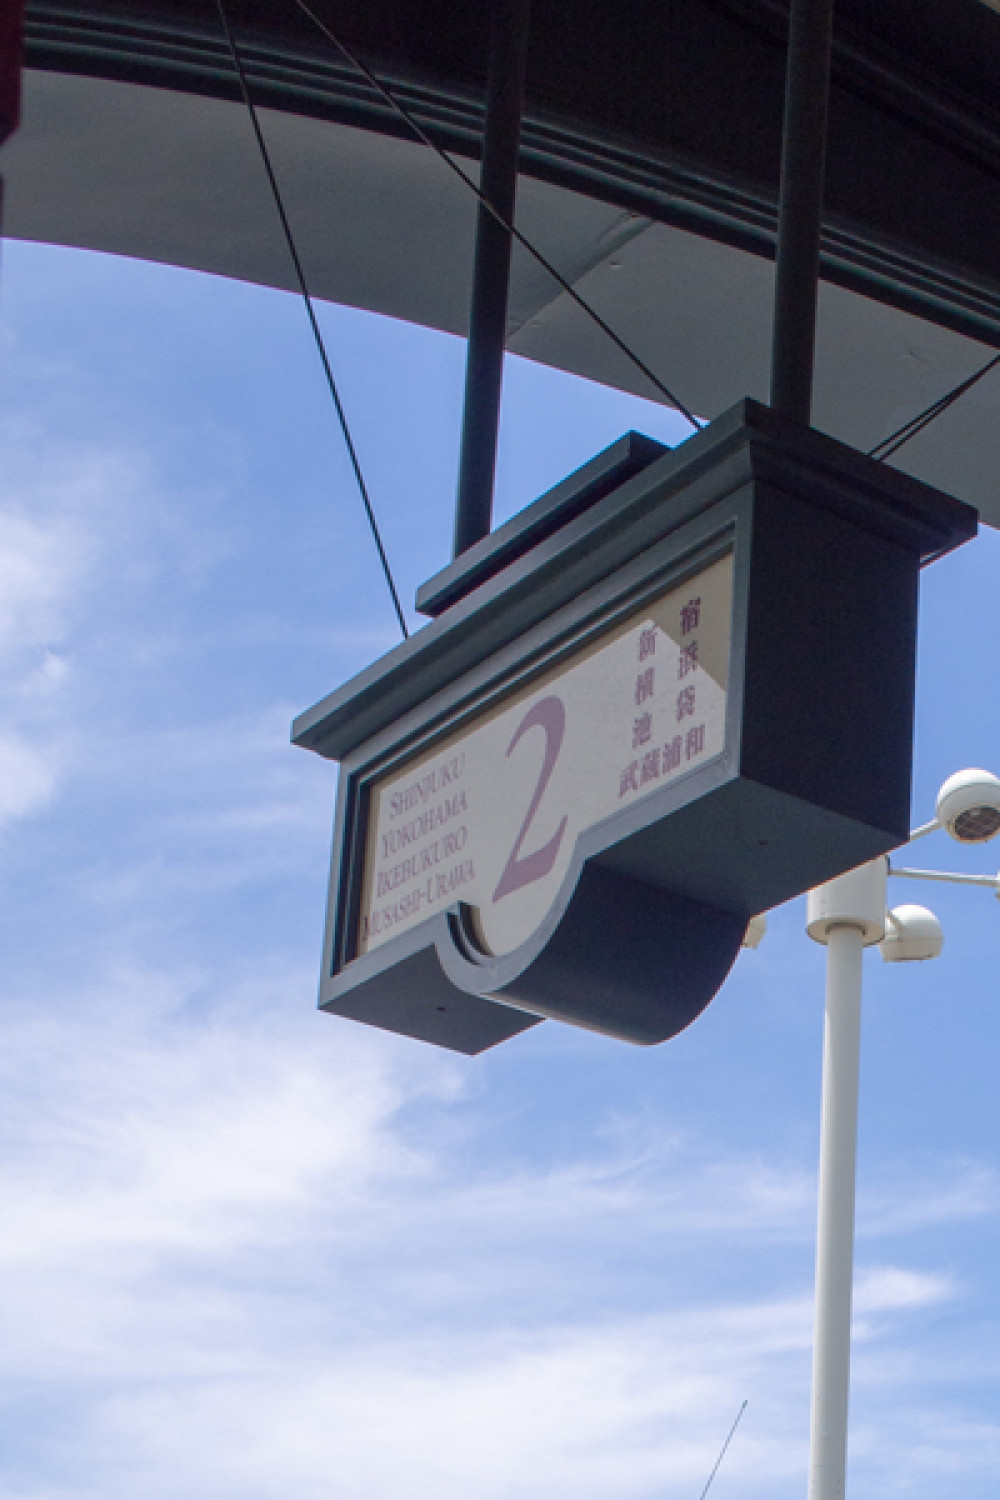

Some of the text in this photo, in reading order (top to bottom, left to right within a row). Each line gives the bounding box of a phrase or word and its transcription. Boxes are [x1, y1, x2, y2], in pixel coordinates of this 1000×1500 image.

[631, 684, 696, 750] 池袋
[389, 752, 464, 820] SHINJUKU
[618, 724, 706, 799] 武蔵浦和
[382, 790, 468, 860] YOKOHAMA
[492, 695, 568, 903] 2
[376, 825, 468, 899] IKEBUKURO
